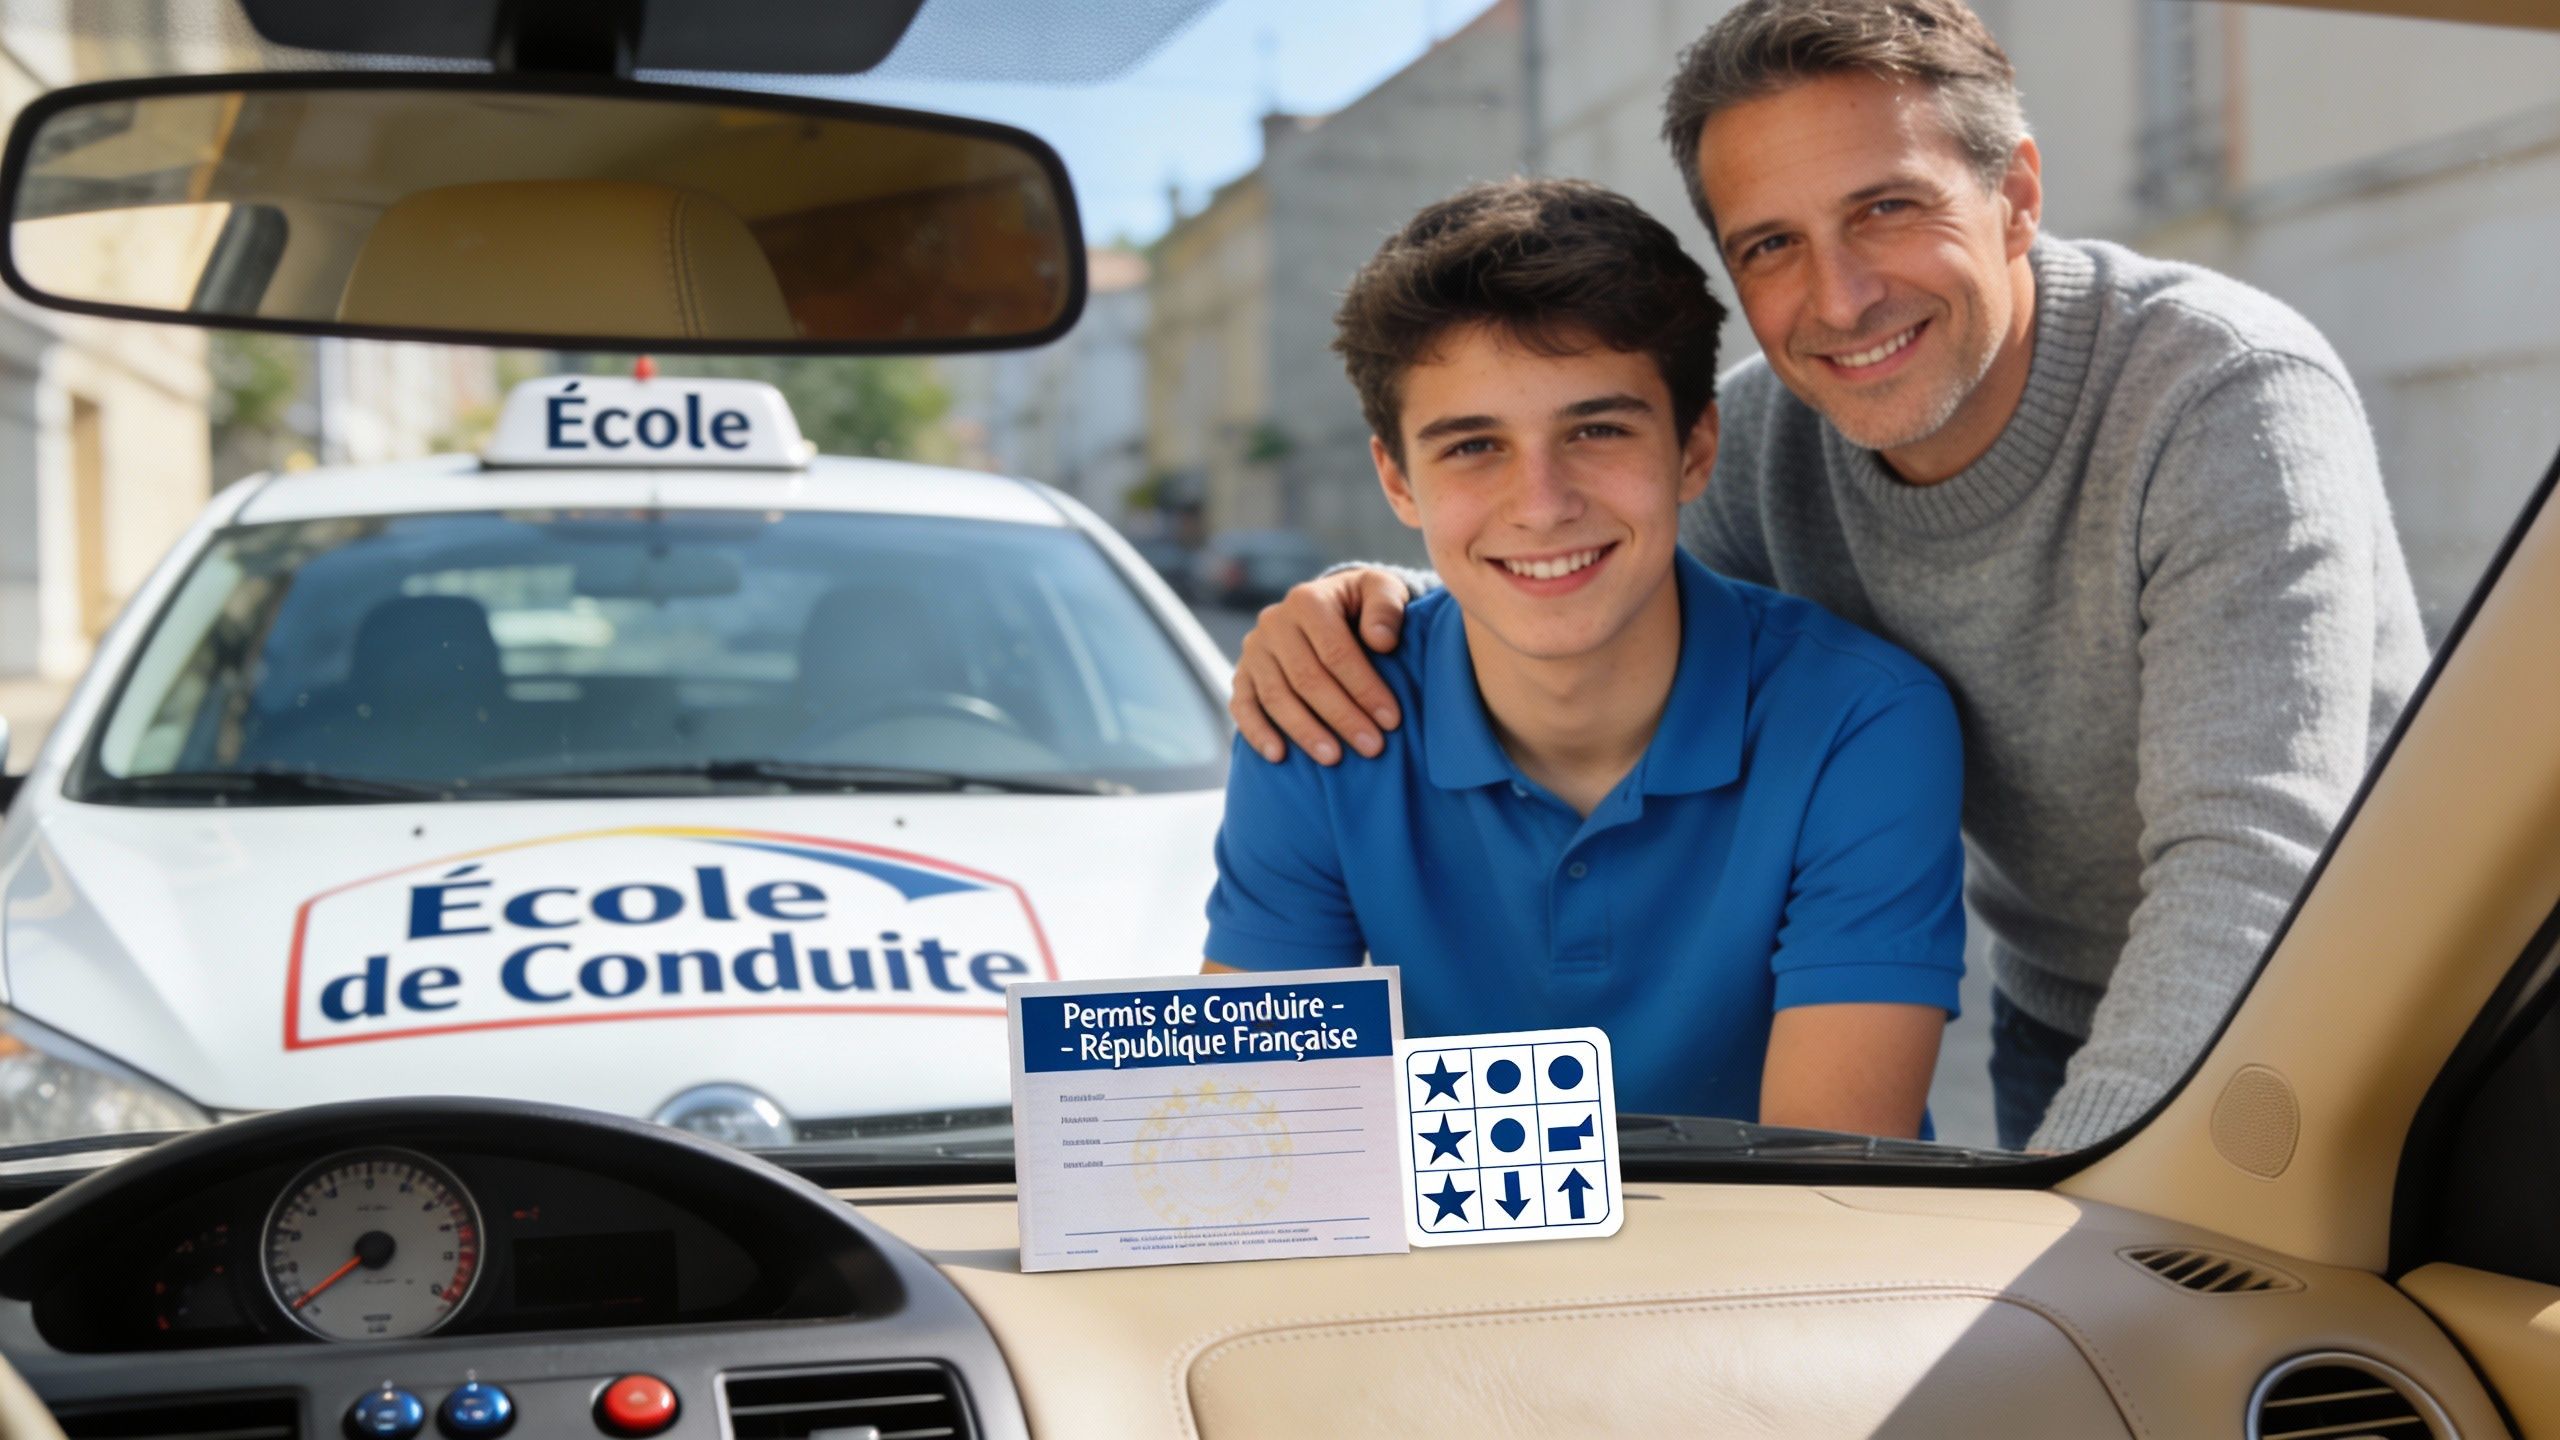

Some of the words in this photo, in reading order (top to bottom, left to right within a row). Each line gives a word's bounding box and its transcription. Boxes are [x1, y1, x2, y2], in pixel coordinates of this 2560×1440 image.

[546, 382, 750, 450] École
[407, 865, 826, 941] École
[319, 955, 461, 1023] de
[500, 931, 1029, 1004] Conduite
[1063, 995, 1156, 1029] Permis
[1163, 995, 1197, 1025] de
[1203, 992, 1325, 1024] Conduire
[1080, 1029, 1227, 1067] République
[1233, 1025, 1358, 1061] Française
